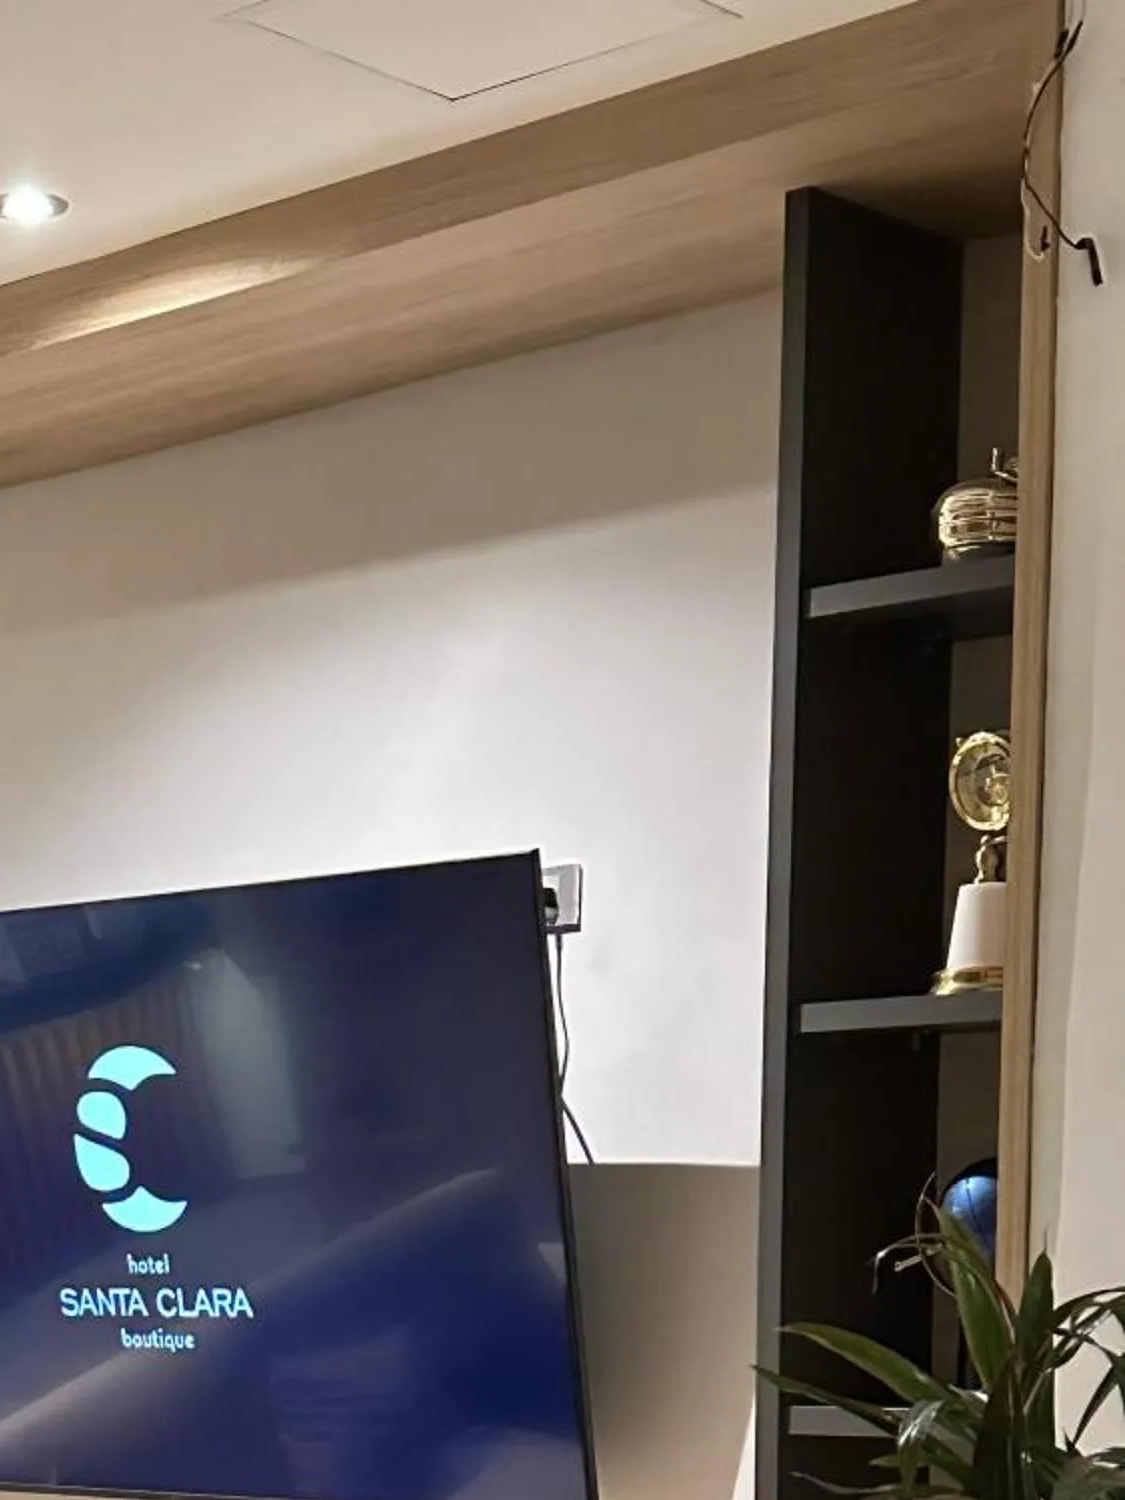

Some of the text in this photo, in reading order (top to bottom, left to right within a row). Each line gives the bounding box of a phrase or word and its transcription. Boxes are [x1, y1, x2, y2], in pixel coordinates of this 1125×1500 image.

[127, 1253, 170, 1274] hotel
[59, 1288, 254, 1318] SANTA CLARA
[120, 1328, 195, 1352] boutique
